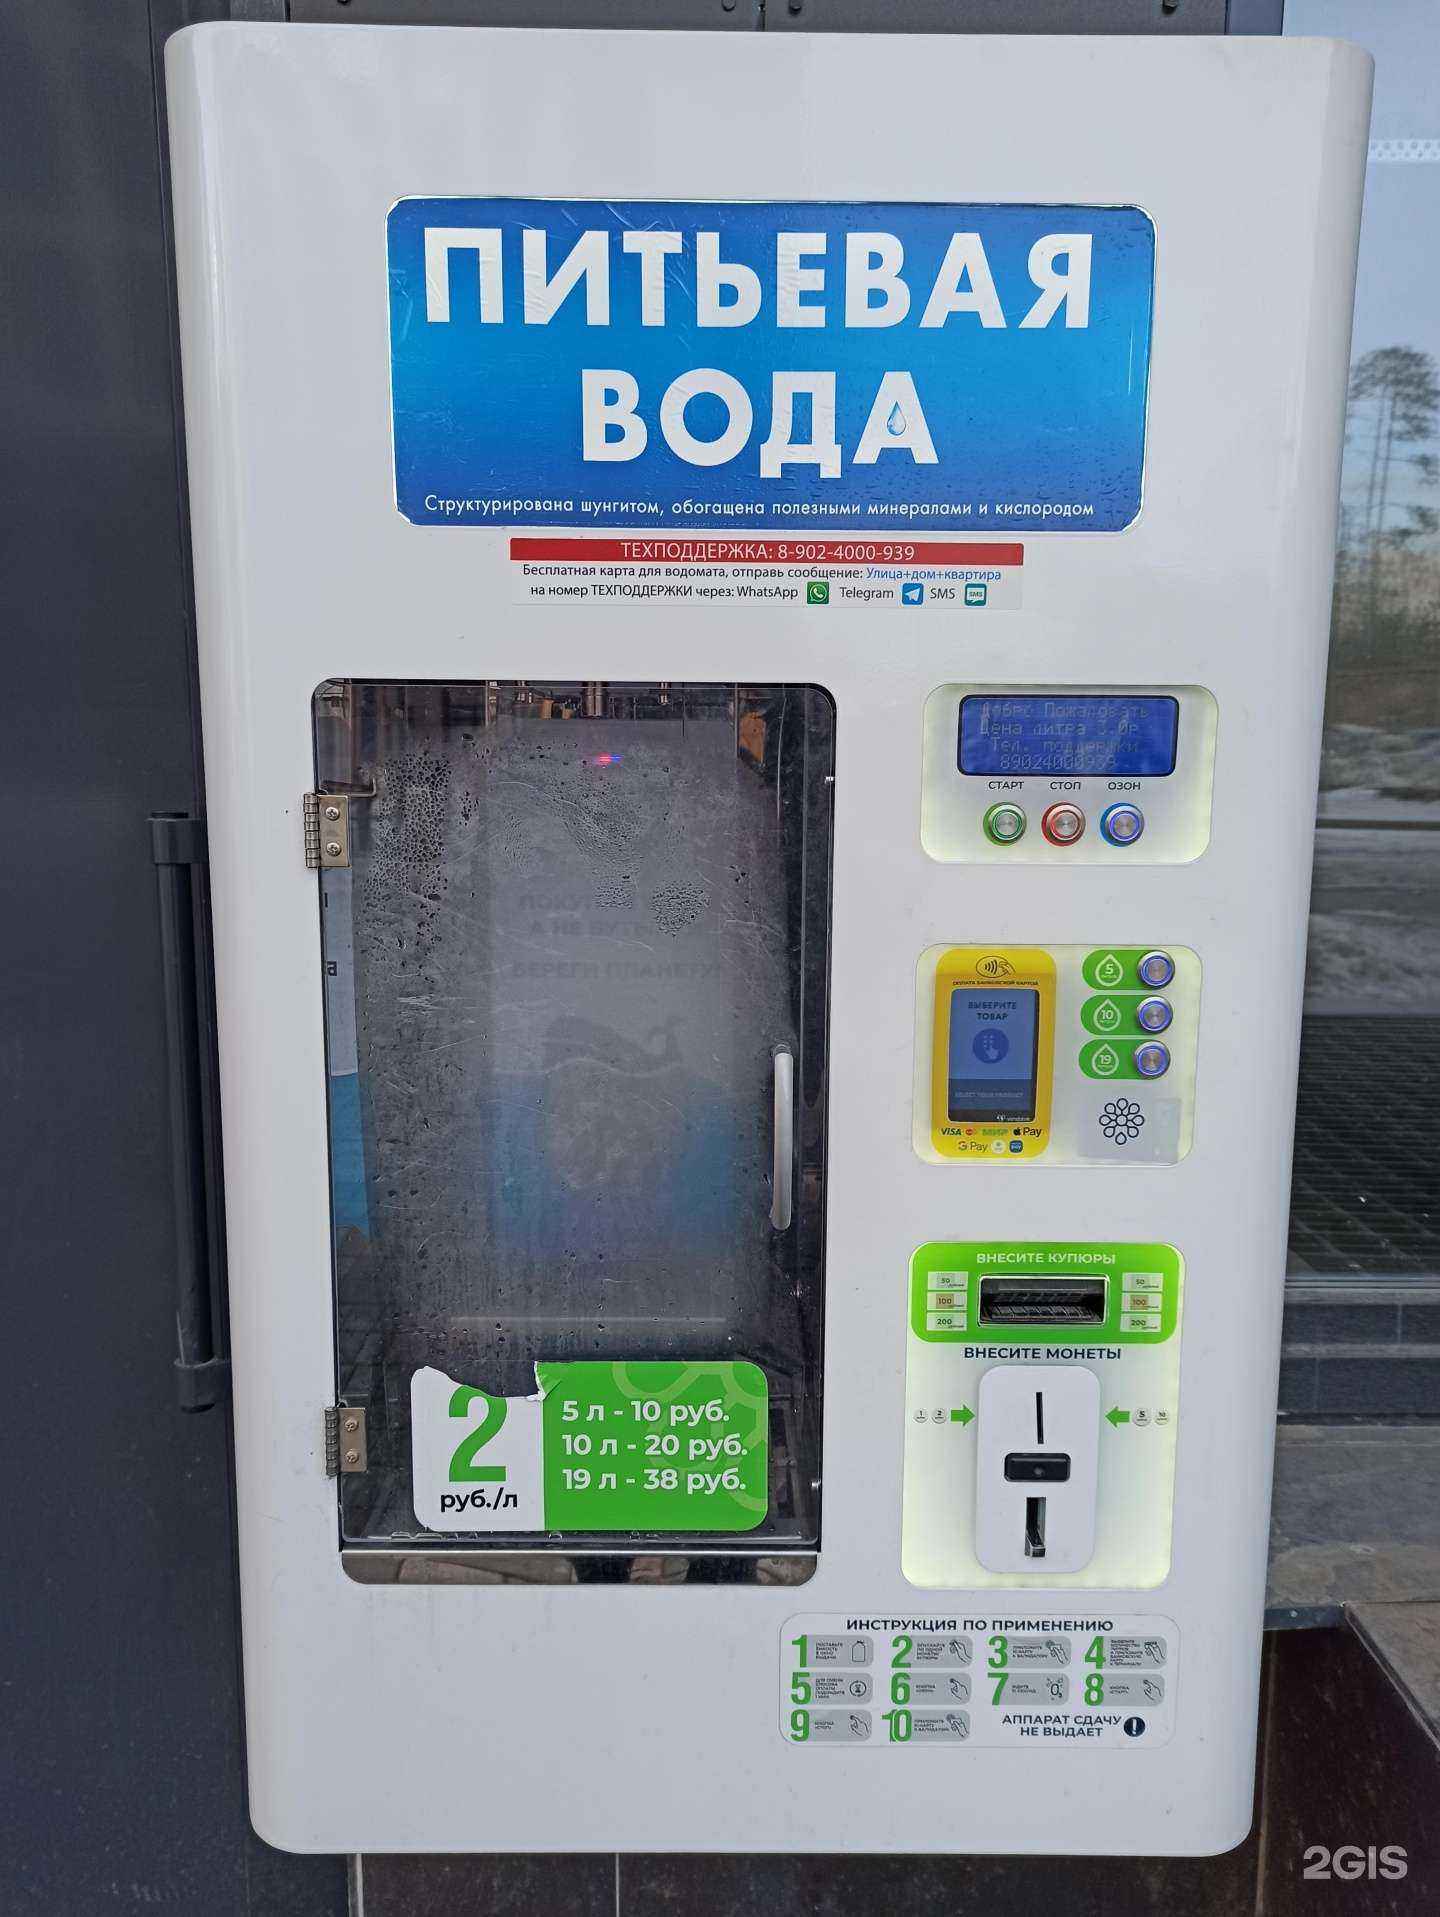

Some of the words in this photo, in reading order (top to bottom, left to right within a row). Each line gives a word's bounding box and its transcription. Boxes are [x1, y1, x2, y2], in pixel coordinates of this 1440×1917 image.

[423, 227, 1094, 329] ПИТЬЕВАЯ
[581, 367, 940, 479] ВОДА
[424, 494, 574, 517] Структурирована
[581, 500, 664, 516] шунгитом,
[672, 499, 765, 516] обогащена
[772, 502, 860, 515] полезными
[867, 503, 971, 518] минералами
[978, 503, 988, 515] и
[995, 503, 1095, 518] кислородом
[621, 542, 773, 562] ТЕХПОДДЕРЖКА:
[777, 543, 915, 561] 8-902-4000-939
[523, 564, 596, 577] Бесплатная
[599, 567, 635, 578] карта
[638, 567, 662, 579] для
[666, 567, 729, 579] водомата,
[732, 567, 785, 580] отправь
[788, 567, 864, 580] сообщение:
[866, 568, 1002, 582] Улица+дом+квартира
[531, 586, 545, 595] на
[548, 586, 588, 598] номер
[591, 585, 693, 599] ТЕХПОДДЕРЖКИ
[696, 586, 734, 599] через:
[737, 586, 799, 600] WhatsApp
[840, 586, 894, 600] Telegram
[930, 588, 956, 598] SMS
[980, 719, 1022, 736] Цена
[988, 781, 1024, 790] СТАРТ
[1050, 781, 1081, 790] СТОП
[1108, 781, 1141, 790] ОЗОН
[1105, 964, 1114, 974] 5
[1101, 1010, 1114, 1020] 10
[1100, 1054, 1111, 1064] 19
[941, 1128, 962, 1136] VISA
[1023, 1127, 1042, 1137] Pay
[970, 1141, 988, 1152] Pay
[977, 1252, 1044, 1264] ВНЕСИТЕ
[1048, 1252, 1116, 1265] КУПЮРЫ
[964, 1347, 1041, 1359] ВНЕСИТЕ
[1046, 1347, 1122, 1360] МОНЕТЫ
[562, 1401, 579, 1421] 5
[586, 1403, 605, 1421] л
[631, 1401, 661, 1422] 10
[669, 1399, 730, 1427] руб.
[448, 1384, 508, 1483] 2
[562, 1434, 592, 1456] 10
[599, 1438, 618, 1456] л
[644, 1434, 680, 1456] 20
[688, 1433, 748, 1461] руб.
[562, 1469, 591, 1490] 19
[598, 1471, 617, 1490] л
[643, 1469, 679, 1490] 38
[687, 1467, 747, 1495] руб.
[440, 1488, 519, 1513] руб./л
[846, 1619, 957, 1633] ИНСТРУКЦИЯ
[963, 1620, 987, 1631] ПО
[992, 1620, 1114, 1632] ПРИМЕНЕНИЮ
[791, 1635, 808, 1667] 1
[891, 1635, 913, 1668] 2
[987, 1635, 1008, 1668] 3
[1084, 1636, 1106, 1669] 4
[790, 1672, 811, 1705] 5
[891, 1672, 911, 1705] 6
[987, 1673, 1009, 1705] 7
[1084, 1673, 1105, 1706] 8
[790, 1709, 810, 1742] 9
[881, 1709, 912, 1743] 10
[1002, 1715, 1070, 1725] АППАРАТ
[1074, 1715, 1122, 1726] СДАЧУ
[1020, 1727, 1038, 1736] НЕ
[1043, 1727, 1104, 1738] ВЫДАЕТ
